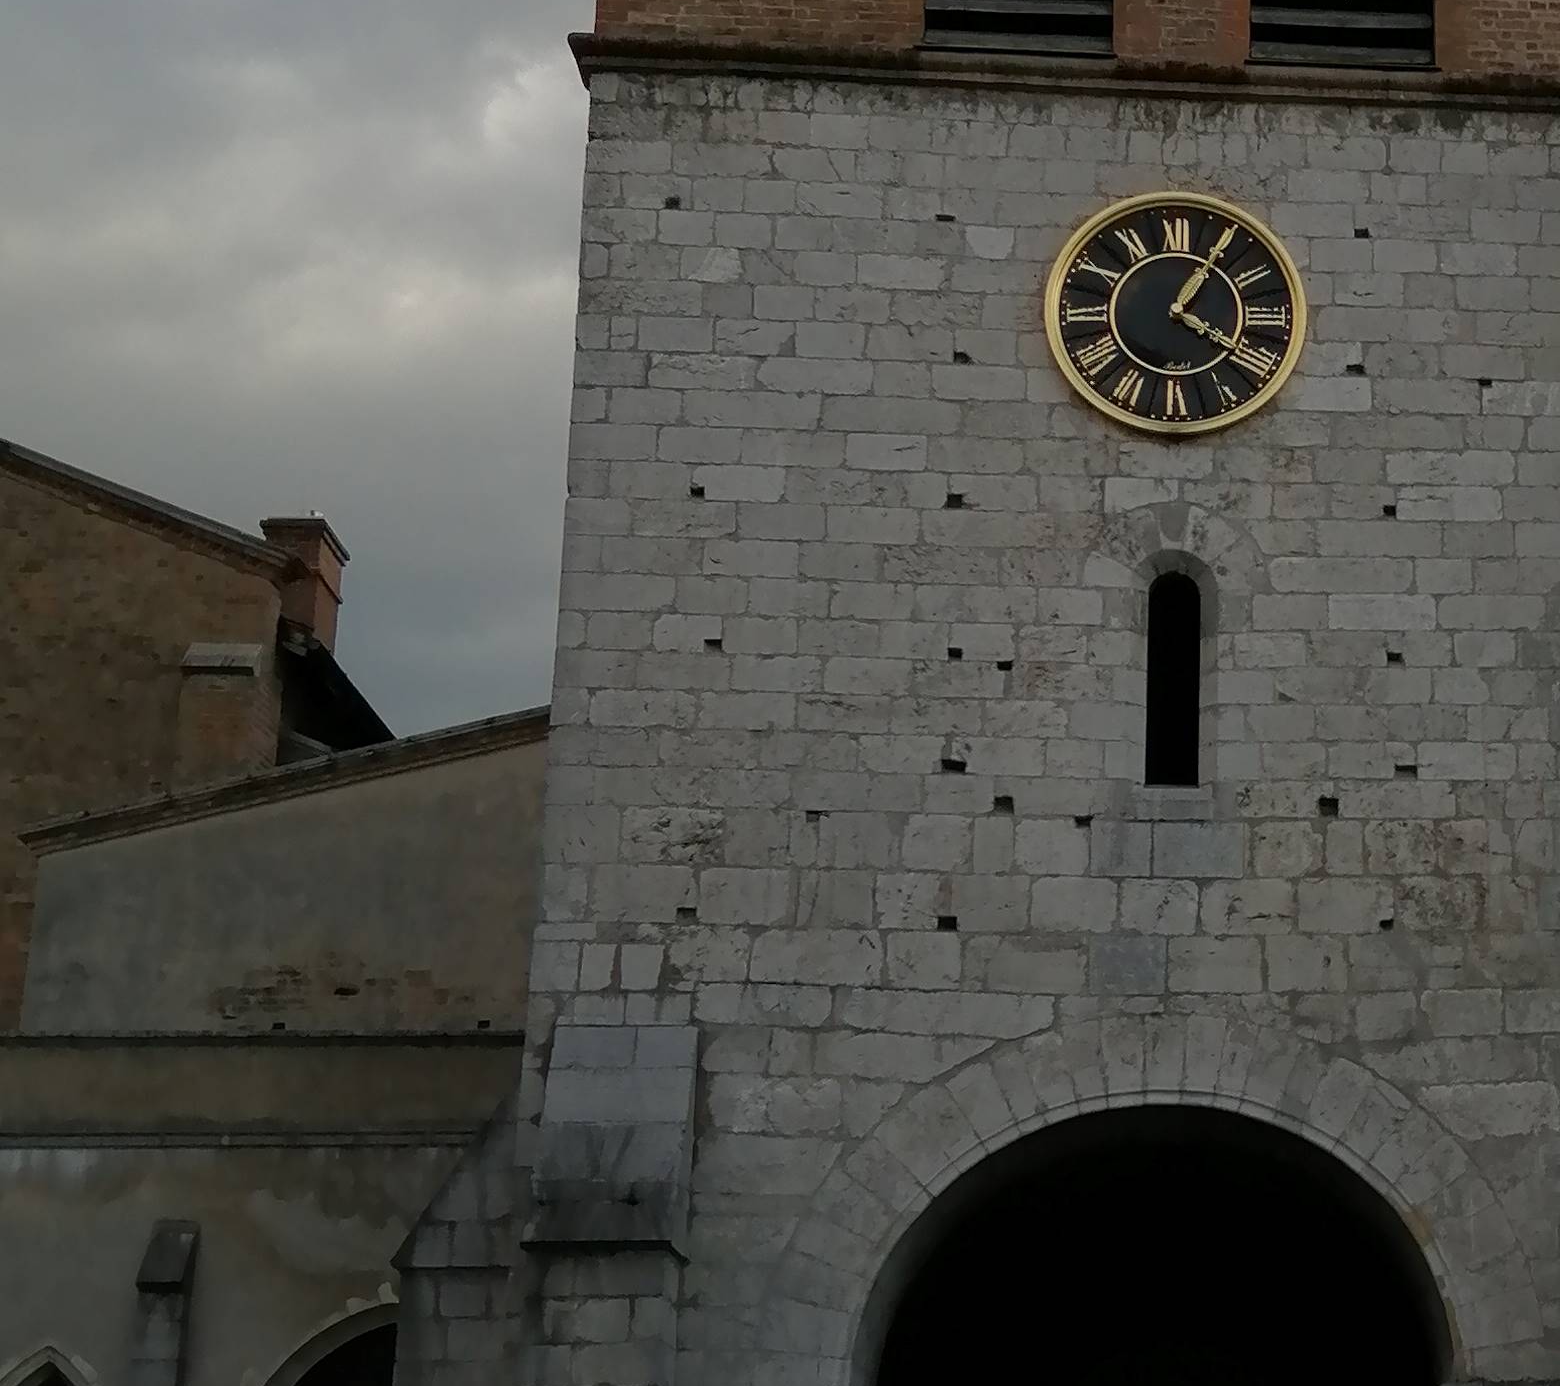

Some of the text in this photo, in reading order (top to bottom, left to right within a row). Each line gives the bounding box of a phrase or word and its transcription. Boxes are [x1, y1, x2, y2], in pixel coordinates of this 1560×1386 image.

[1114, 226, 1149, 264] XI
[1161, 217, 1191, 253] XII
[1078, 256, 1122, 287] X
[1244, 305, 1287, 328] III
